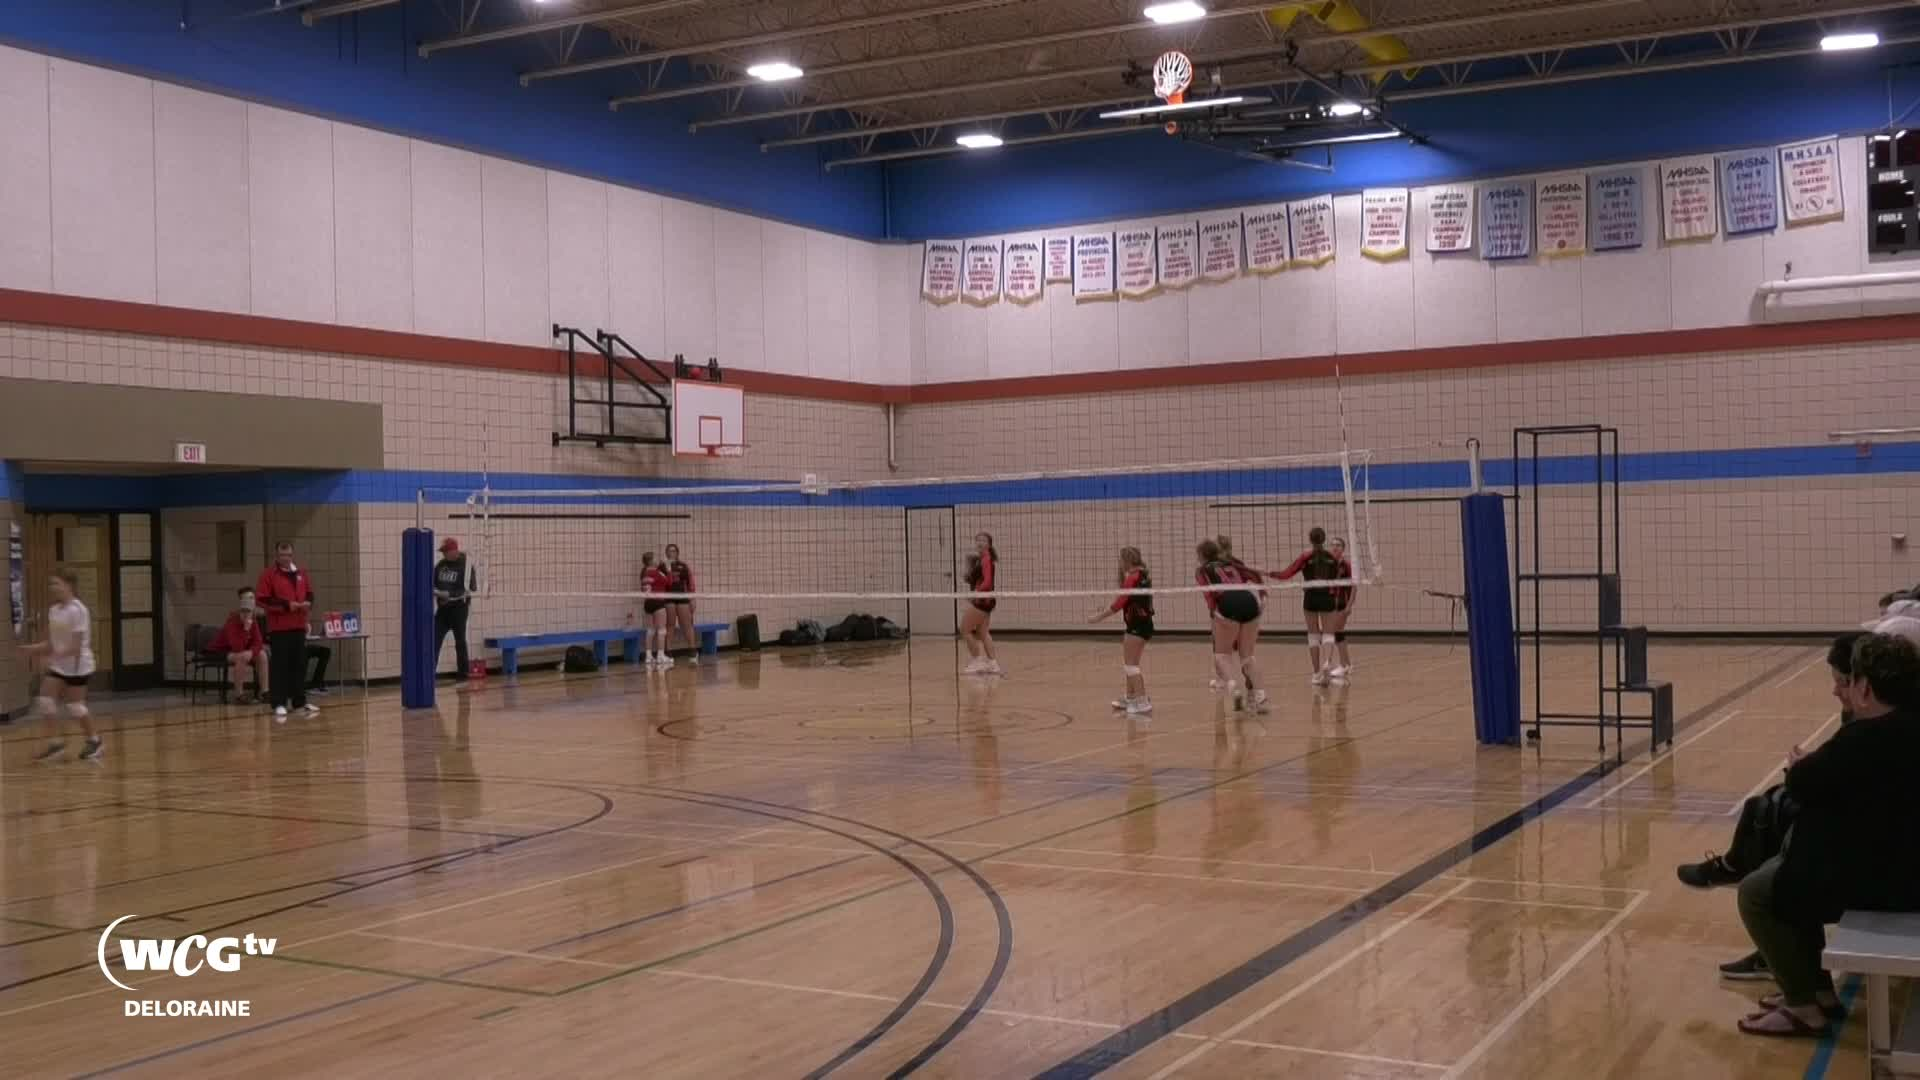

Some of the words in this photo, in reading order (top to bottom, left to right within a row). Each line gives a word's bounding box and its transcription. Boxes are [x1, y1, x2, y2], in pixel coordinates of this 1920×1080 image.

[1727, 157, 1770, 170] MHSAA
[1667, 166, 1711, 179] MHSAA
[1879, 170, 1904, 182] HOME
[1541, 183, 1583, 195] MHSAA
[1597, 176, 1637, 189] MHSAA
[1488, 188, 1525, 201] MHSAA
[1878, 213, 1903, 223] FOULS
[183, 446, 200, 461] EXIT
